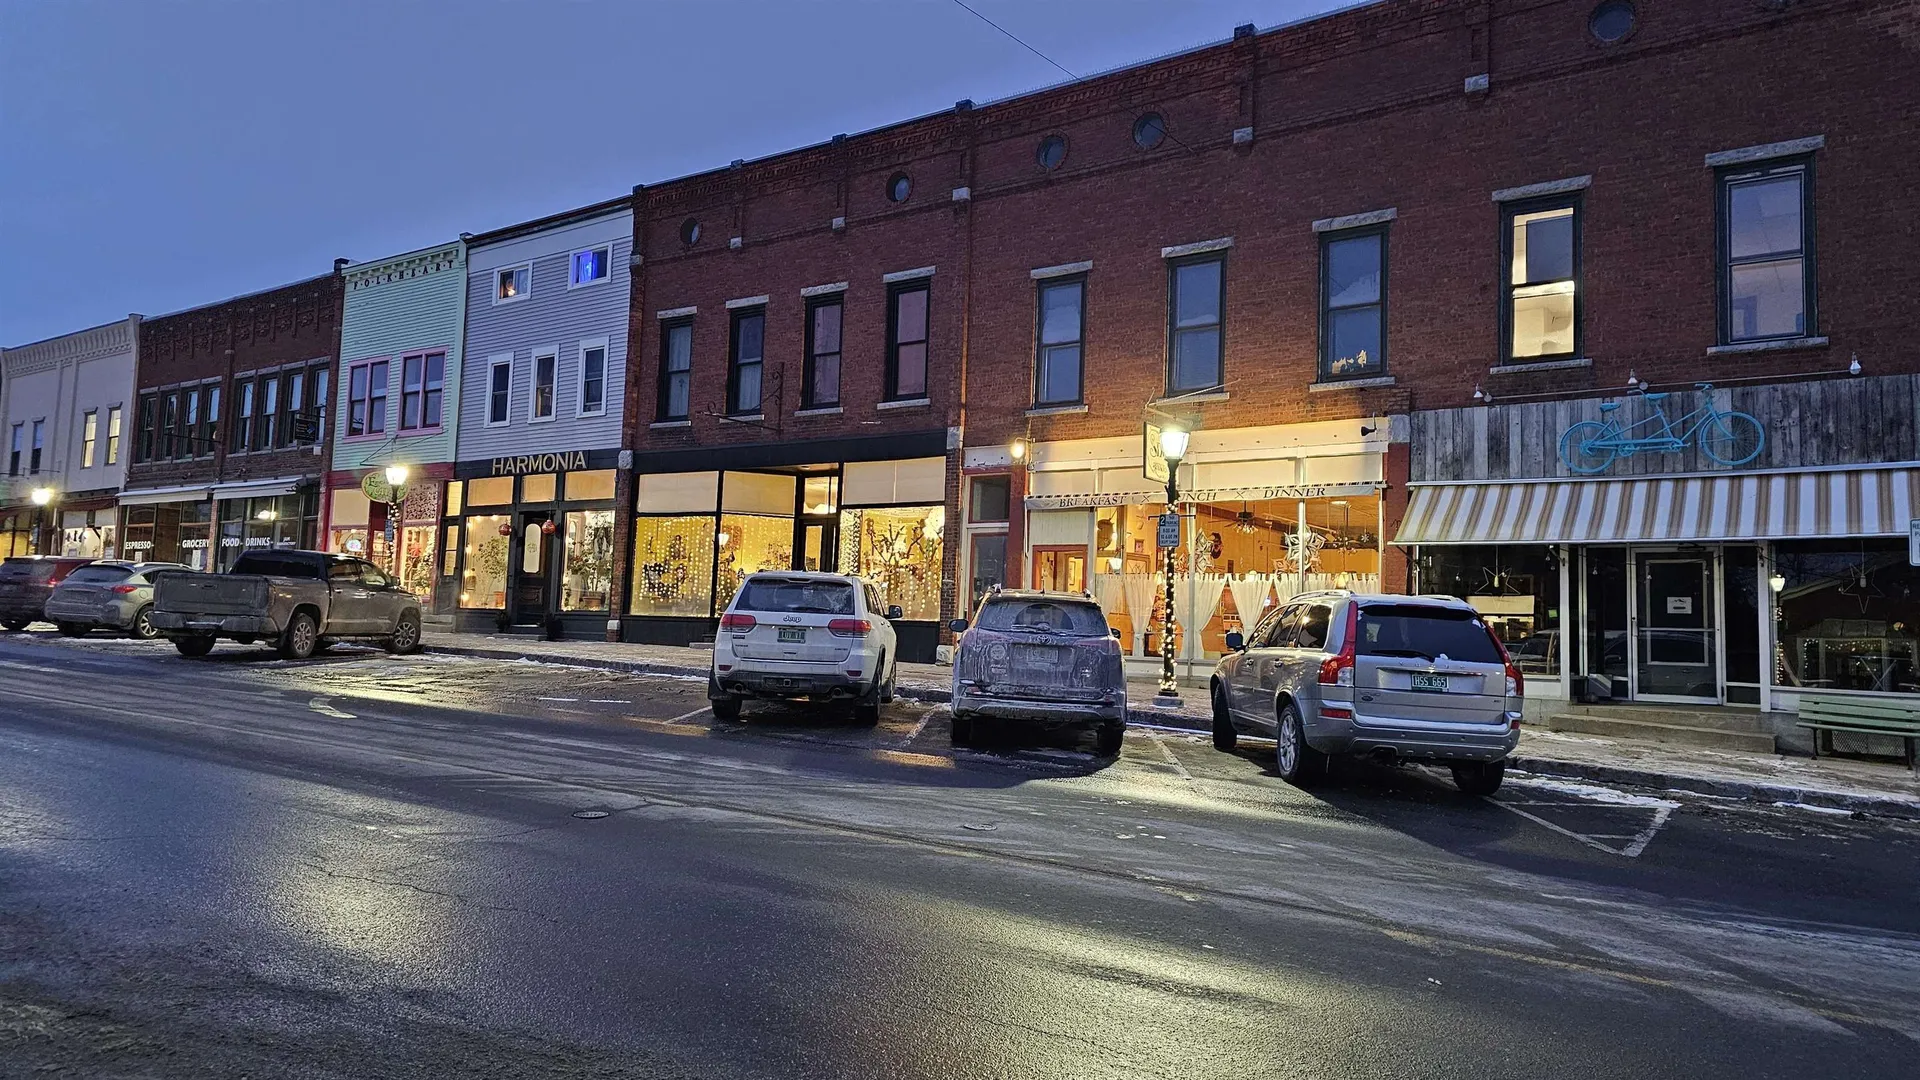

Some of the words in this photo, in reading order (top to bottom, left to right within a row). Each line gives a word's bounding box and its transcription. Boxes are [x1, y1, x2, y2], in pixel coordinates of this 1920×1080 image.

[492, 451, 587, 475] HARMONIA
[1059, 495, 1127, 508] BREAKFAST
[1180, 492, 1217, 502] UNCH
[1263, 487, 1326, 499] DINNER
[1160, 516, 1165, 525] 2
[125, 540, 151, 550] ESPRESSO
[182, 538, 209, 549] GROCERY
[221, 538, 240, 547] FOOD
[245, 537, 271, 547] DRINKS
[782, 615, 802, 623] Jeep
[1414, 676, 1429, 686] HSS
[1432, 677, 1446, 688] 665
